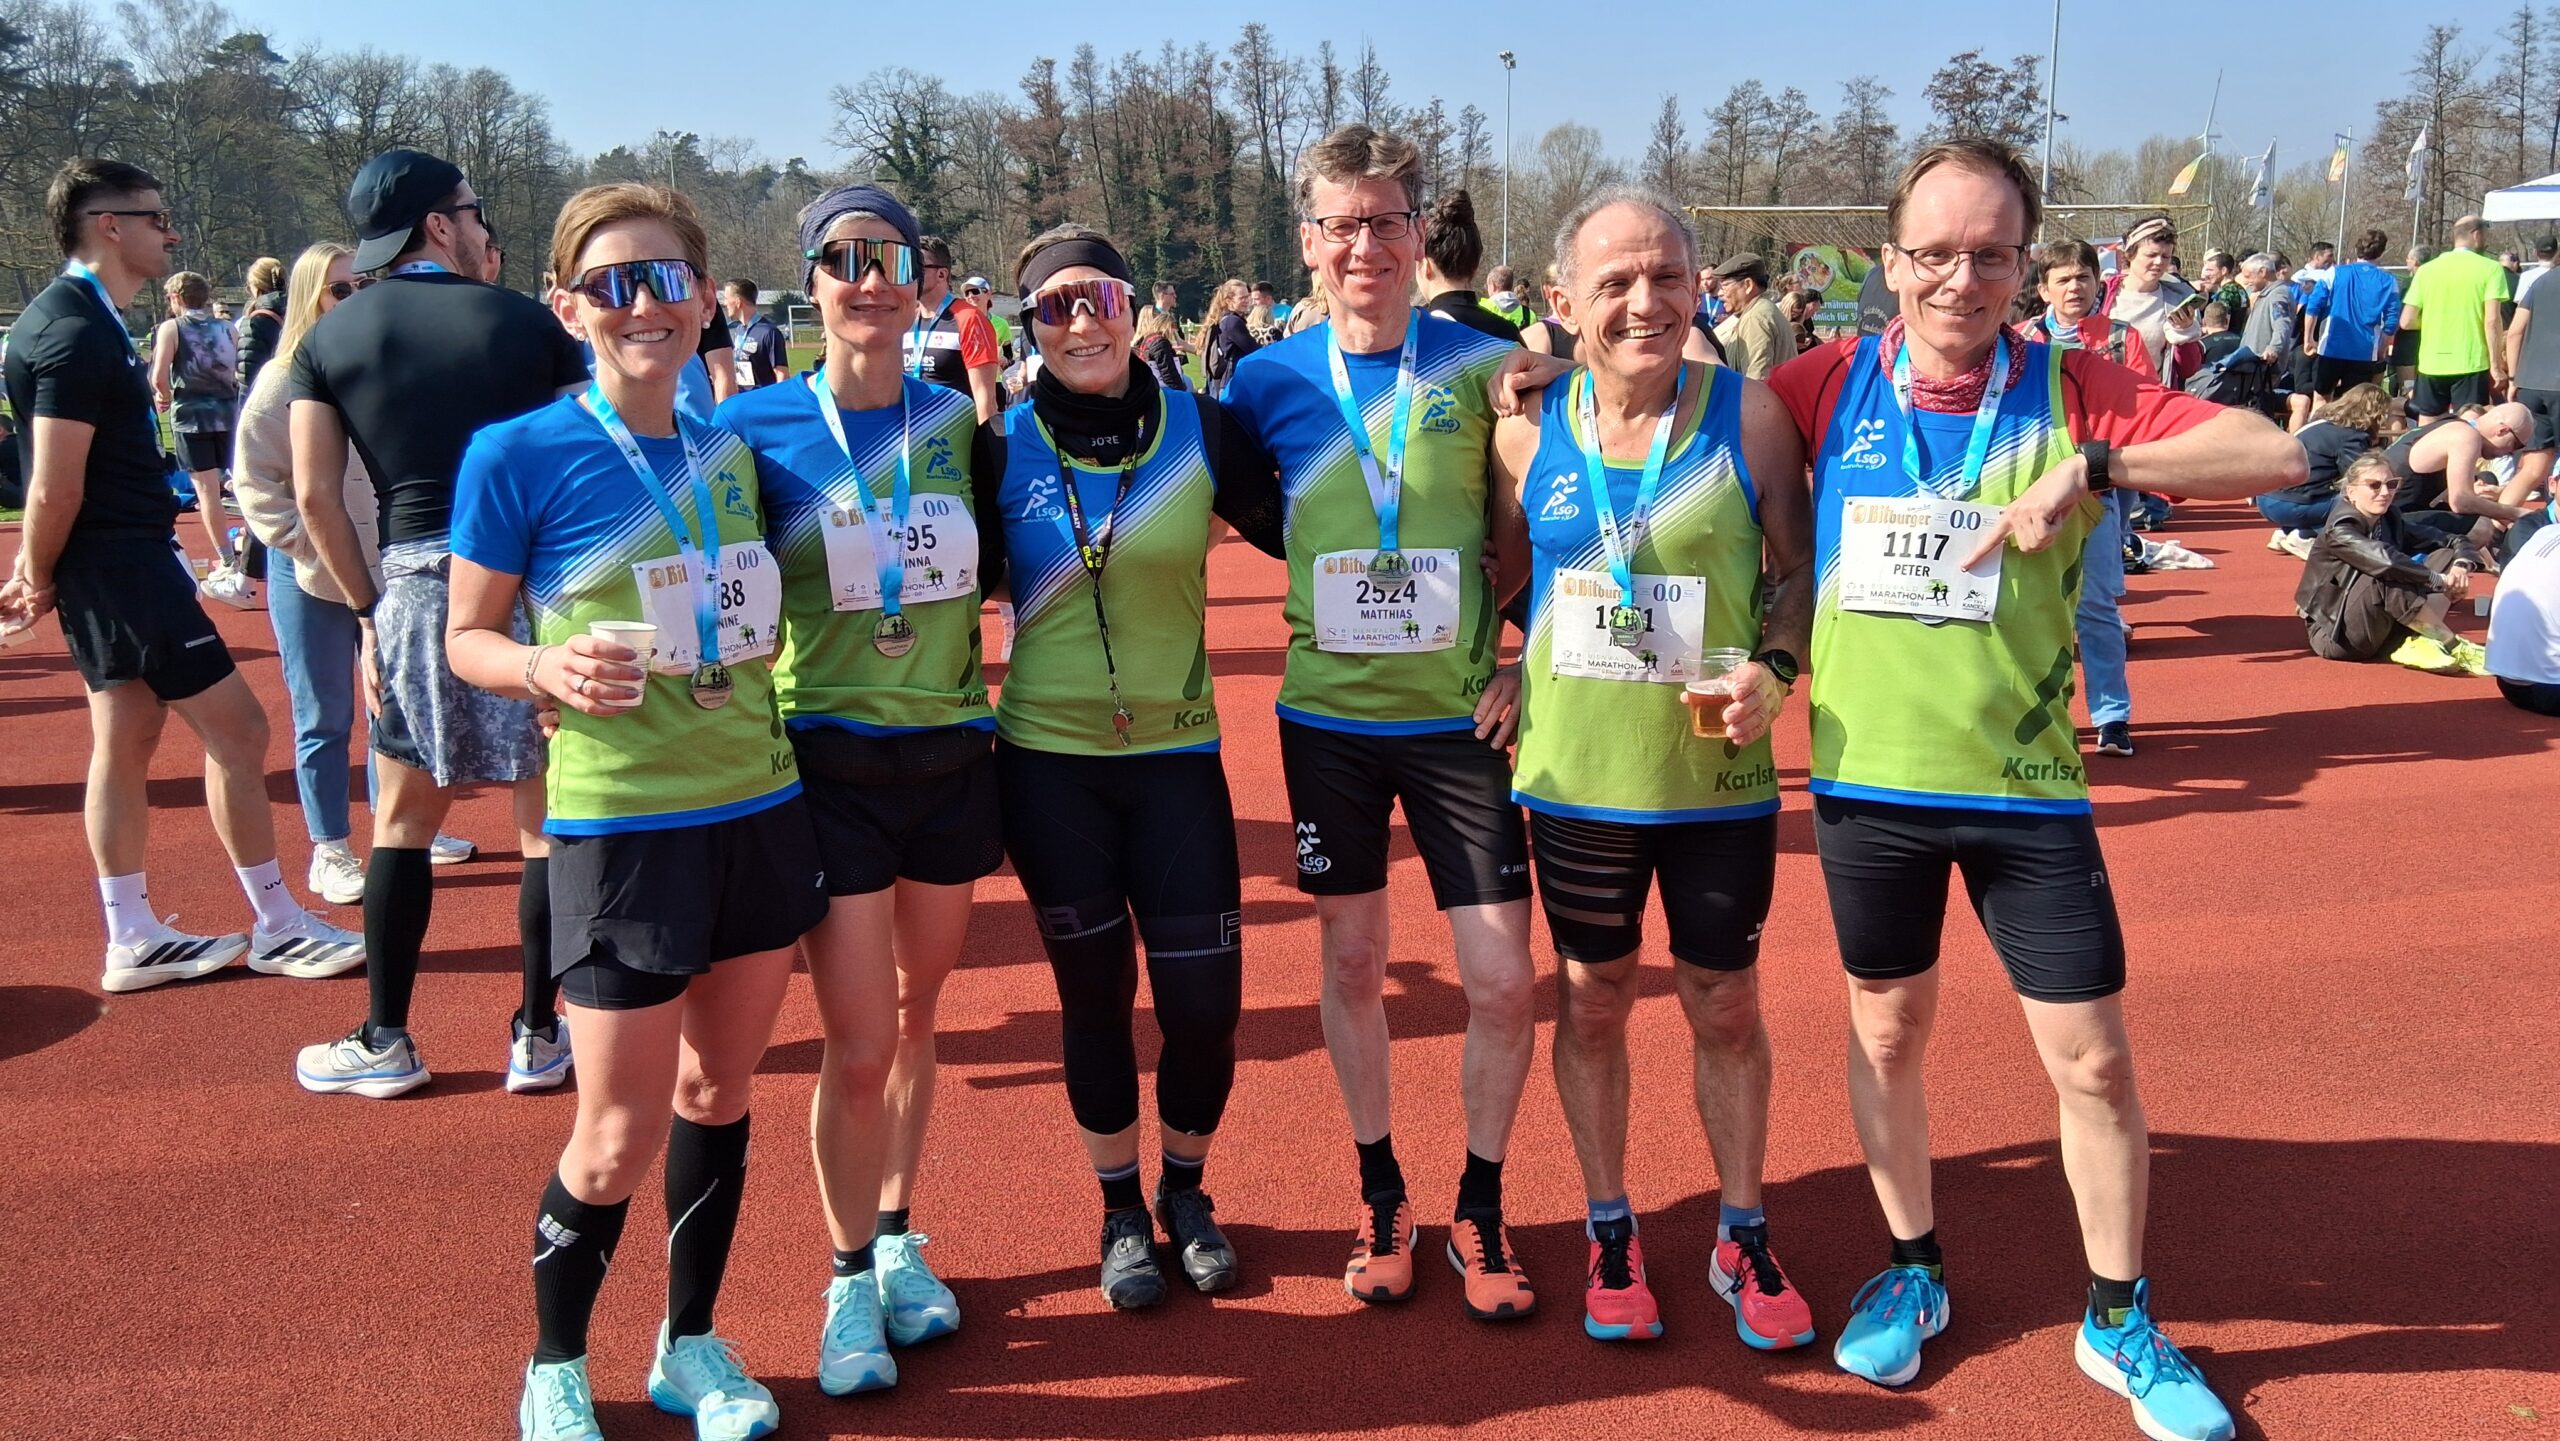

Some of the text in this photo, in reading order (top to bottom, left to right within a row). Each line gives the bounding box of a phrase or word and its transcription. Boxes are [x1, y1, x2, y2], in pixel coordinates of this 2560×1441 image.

[1435, 418, 1454, 428] LSG
[1855, 453, 1880, 464] LSG
[941, 467, 957, 476] LSG
[923, 500, 949, 517] 0.0
[1036, 507, 1057, 516] LSG
[1553, 506, 1573, 515] LSG
[1867, 504, 1931, 527] Bitburger
[1950, 509, 1981, 531] 0.0
[1883, 531, 1950, 561] 1117
[736, 548, 759, 571] 0.0
[904, 555, 931, 568] INNA
[1411, 556, 1438, 574] 0.0
[1893, 564, 1931, 577] PETER
[720, 579, 746, 610] 88
[1356, 580, 1418, 604] 2524
[1653, 583, 1681, 603] 0.0
[1870, 590, 1925, 601] MARATHON
[1360, 608, 1413, 620] MATTHIAS
[717, 614, 741, 630] NINE
[1352, 633, 1401, 641] MARATHON
[1587, 659, 1638, 671] MARATHON
[1303, 855, 1325, 867] LSG
